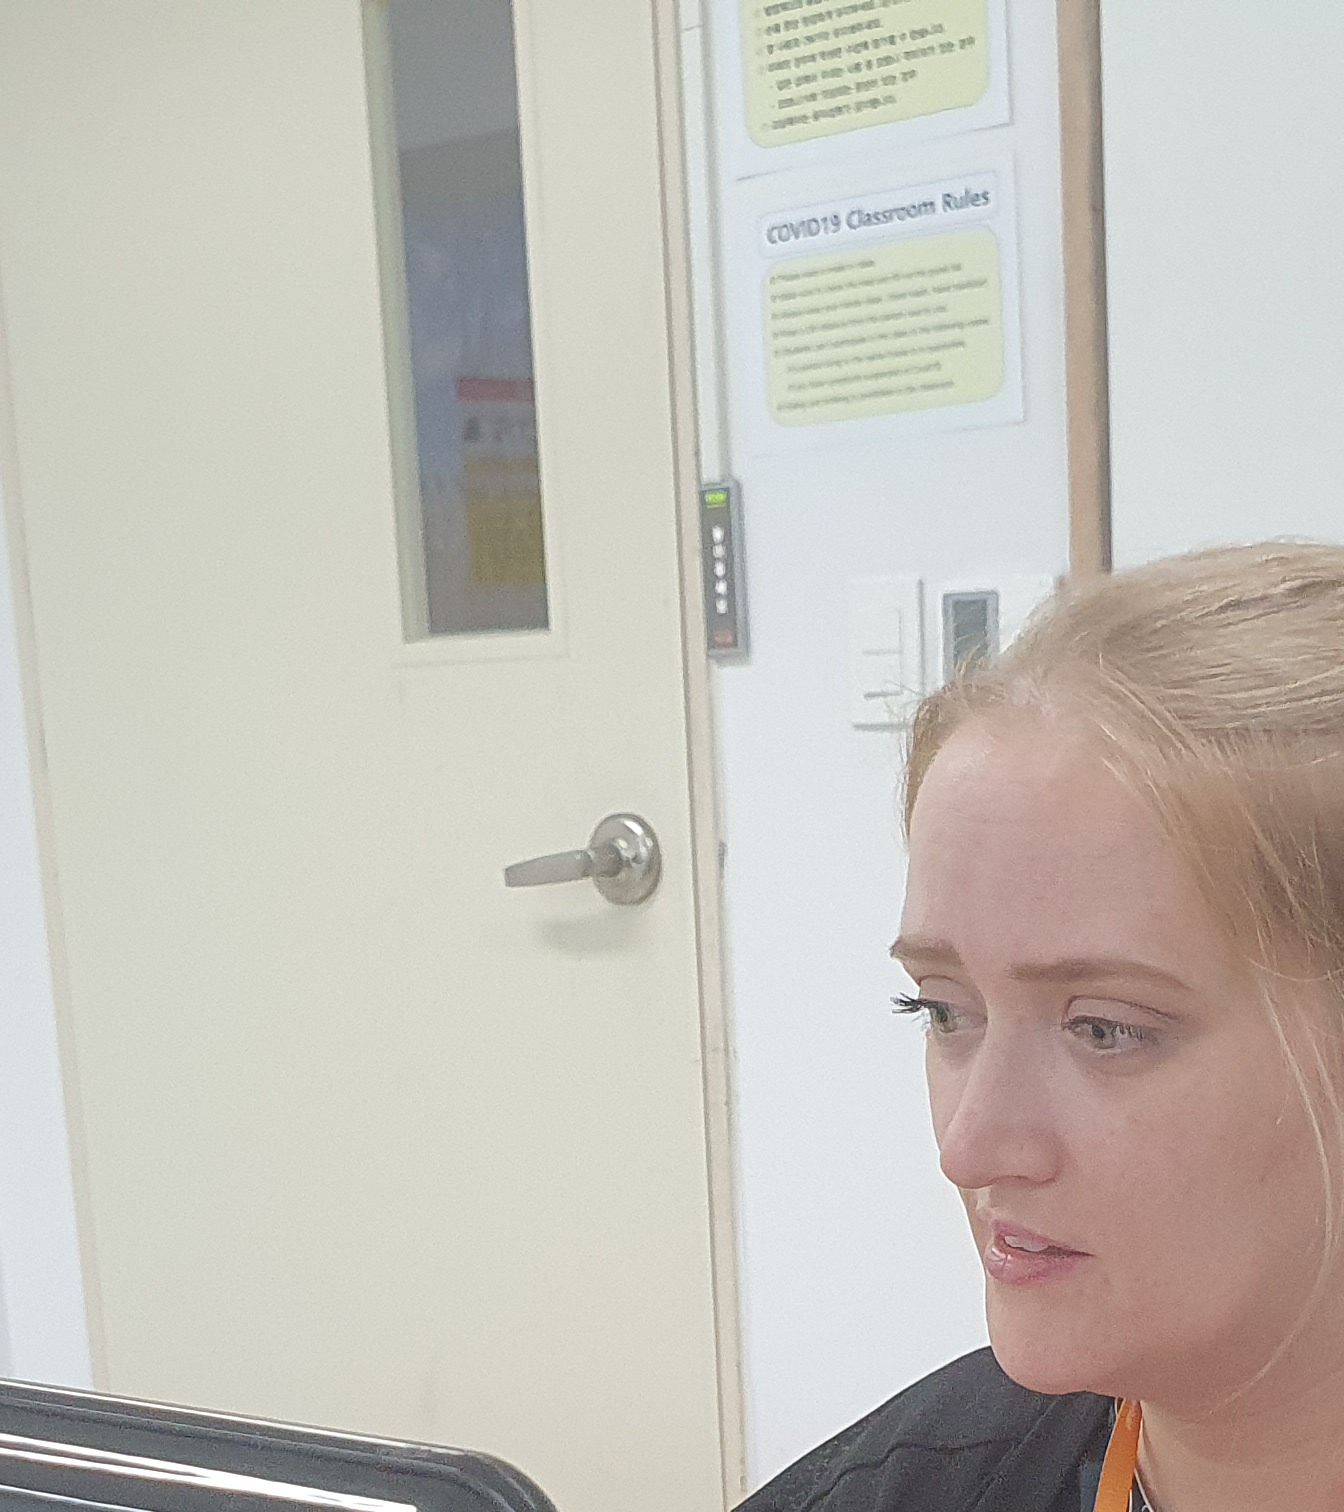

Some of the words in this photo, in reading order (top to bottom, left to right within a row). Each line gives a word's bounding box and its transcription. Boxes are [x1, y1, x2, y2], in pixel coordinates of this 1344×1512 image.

[766, 214, 840, 245] COVID19
[846, 200, 936, 230] Classroom
[941, 187, 991, 213] Rules
